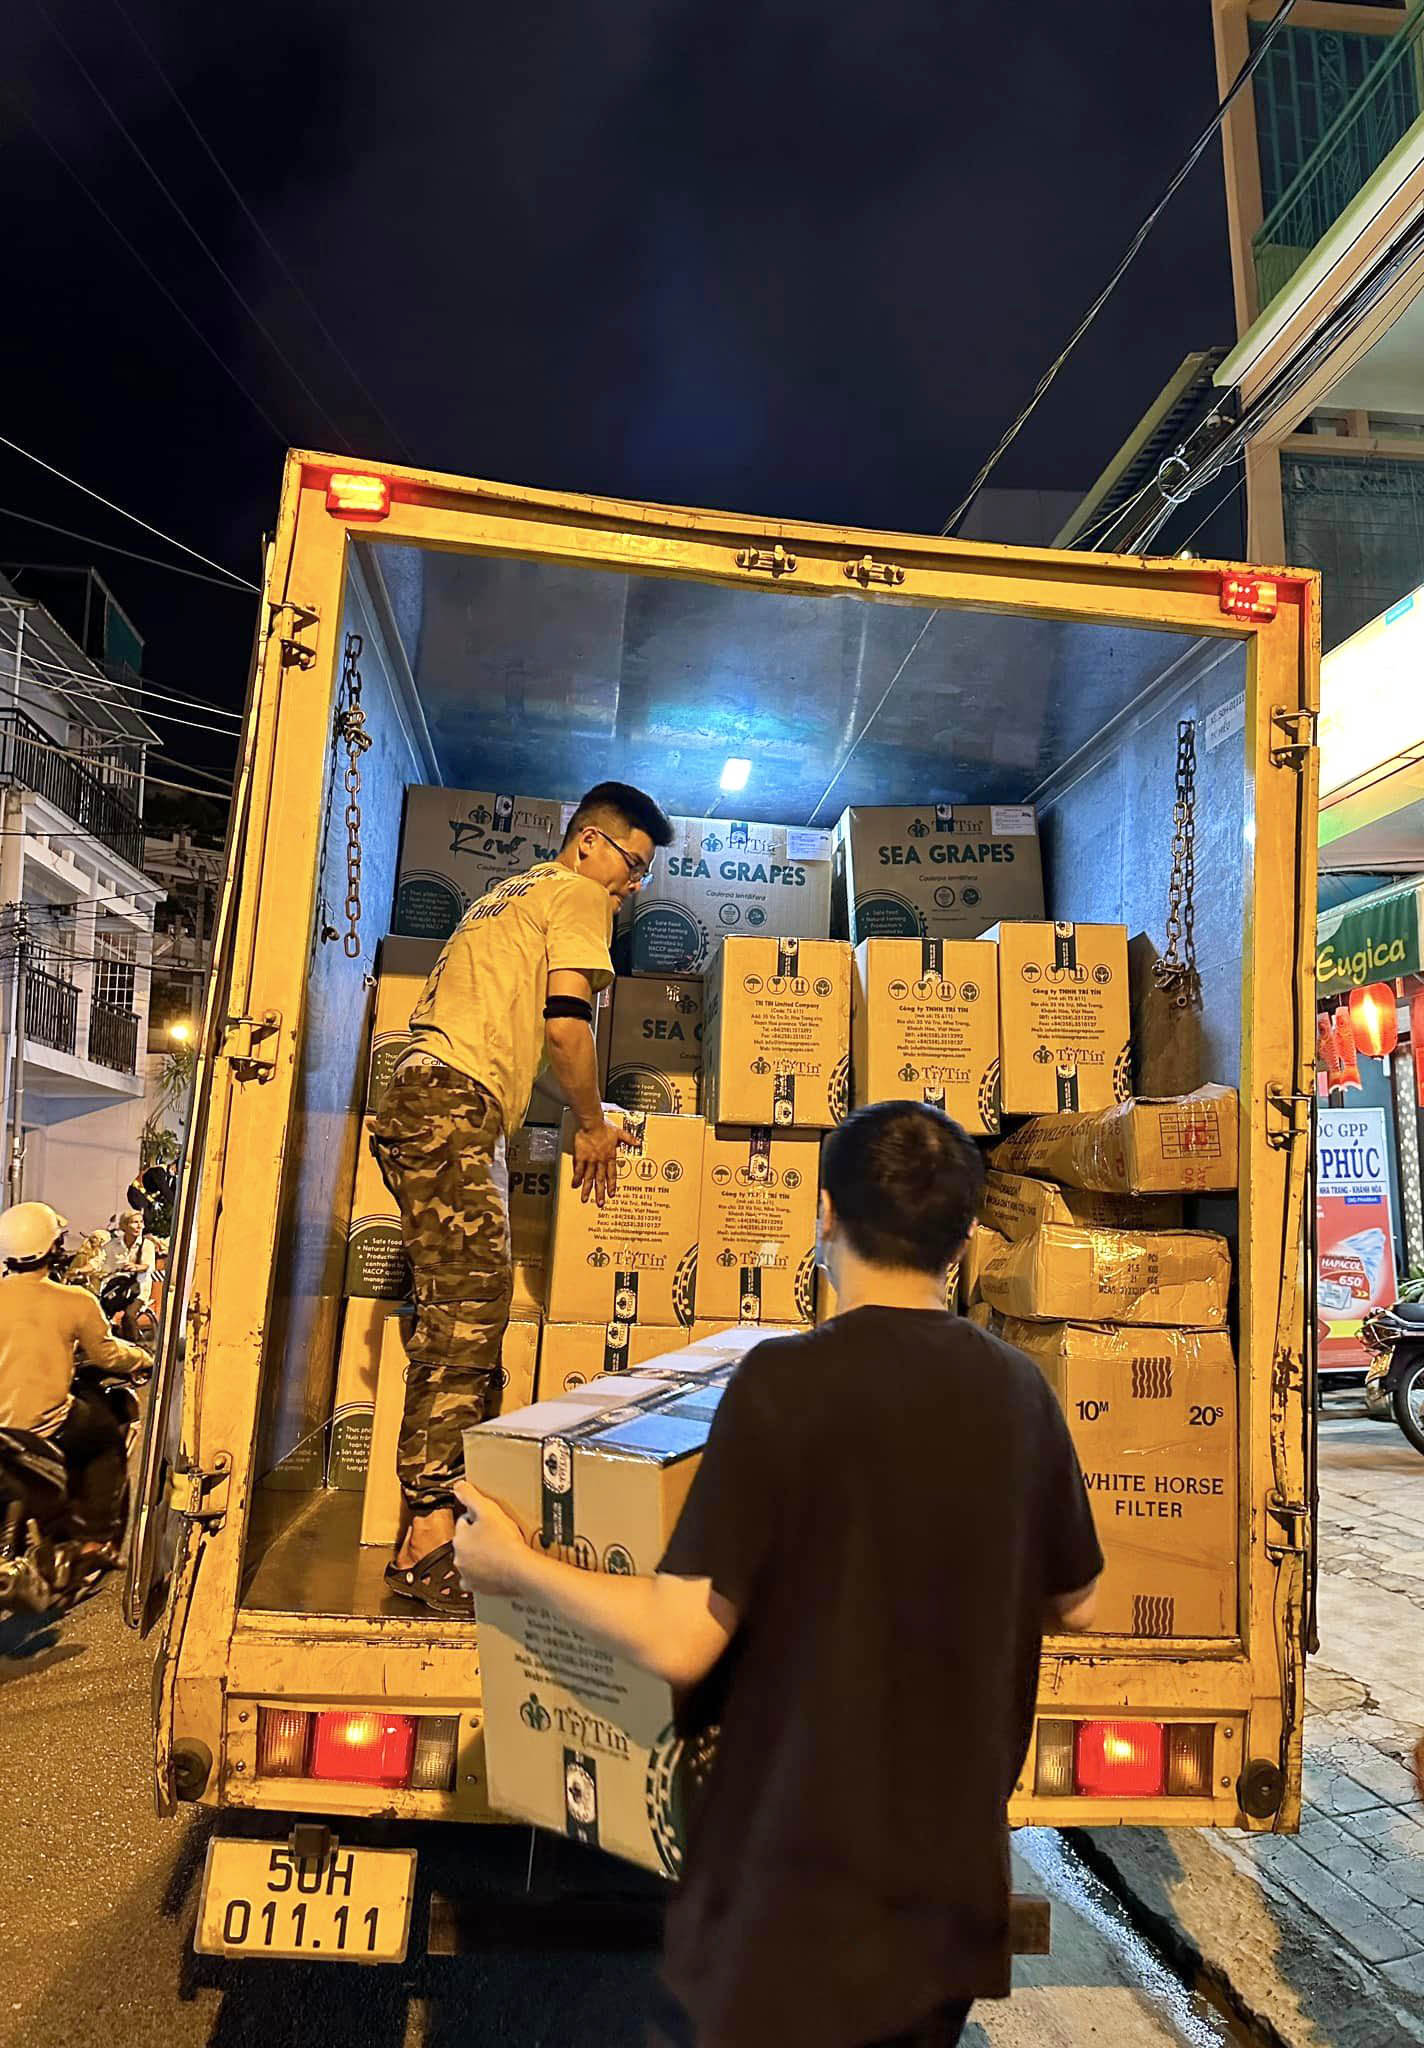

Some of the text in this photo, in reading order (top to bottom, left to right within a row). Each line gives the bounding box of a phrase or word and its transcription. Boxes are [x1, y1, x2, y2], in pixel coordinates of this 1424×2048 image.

[878, 844, 1015, 865] SEA GRAPES
[668, 857, 806, 886] SEA GRAPES
[1316, 938, 1406, 984] Eugica
[642, 1018, 685, 1040] SEA
[1338, 1123, 1368, 1137] GPP
[1320, 1139, 1380, 1178] PHÚC
[1331, 1186, 1348, 1194] TRANG
[1321, 1258, 1361, 1270] HAPACOL
[1339, 1276, 1361, 1286] 650
[1154, 1476, 1224, 1494] HORSE
[1115, 1500, 1183, 1518] FILTER
[223, 1900, 379, 1951] 011.11
